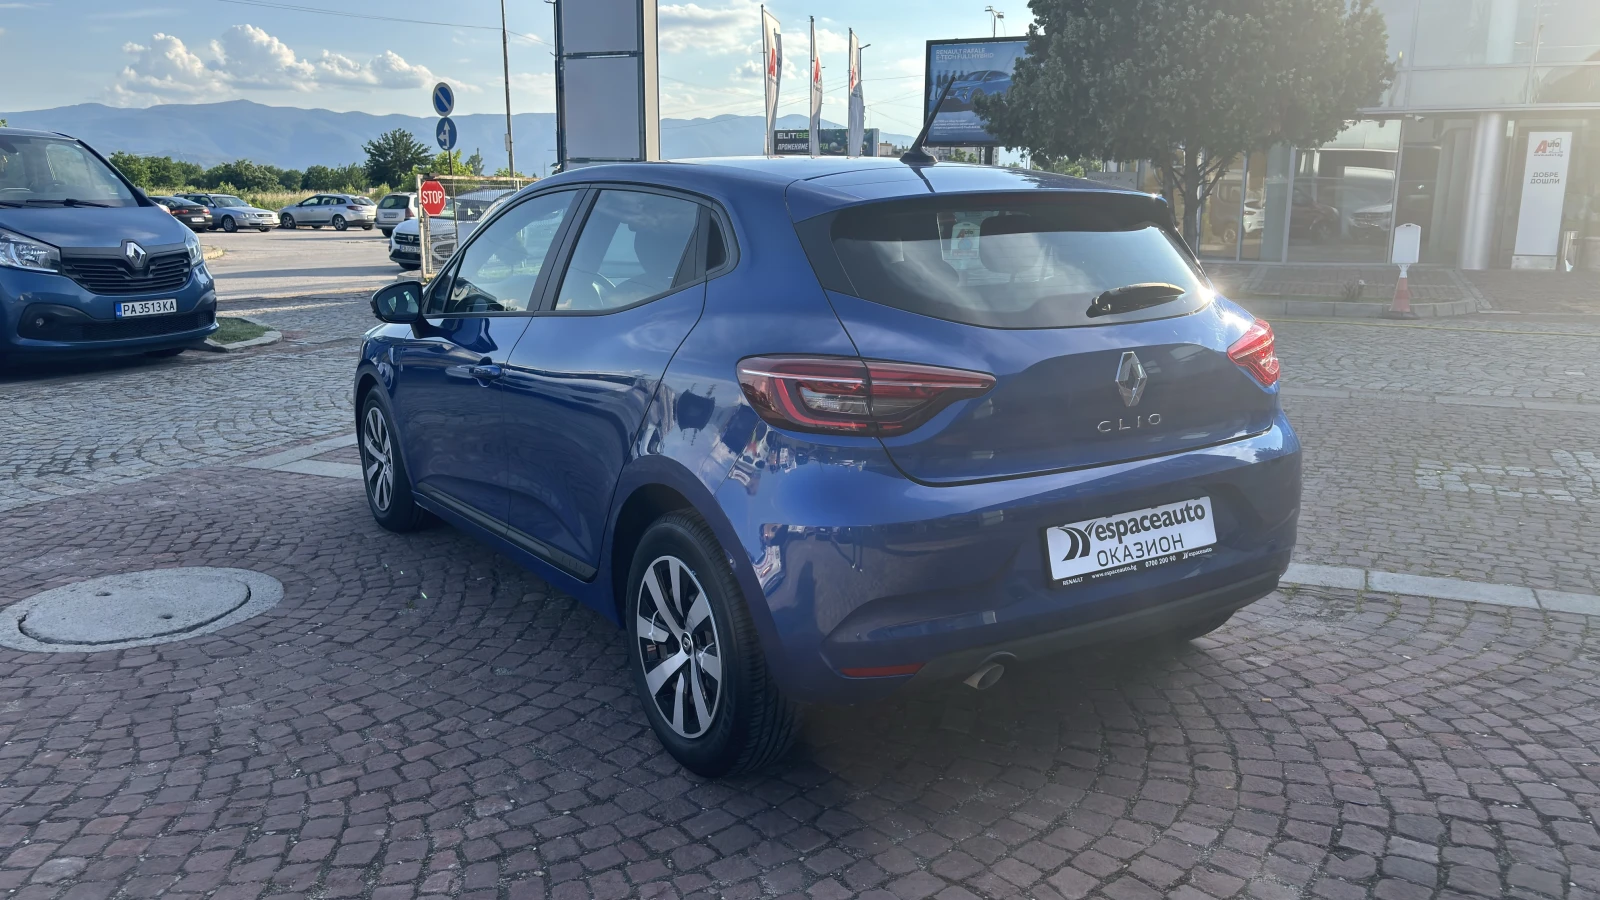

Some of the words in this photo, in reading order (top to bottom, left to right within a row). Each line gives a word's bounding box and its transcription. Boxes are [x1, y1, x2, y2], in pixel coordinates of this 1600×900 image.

[422, 190, 443, 205] STOP
[1097, 413, 1162, 433] CLIO
[1094, 502, 1206, 545] espaceauto
[1062, 576, 1083, 586] RENAULT
[1091, 564, 1138, 579] www.espaceauto.bg
[1159, 556, 1169, 565] 200
[1188, 547, 1213, 558] espaceauto
[1097, 532, 1185, 567] ОКАЗИОН
